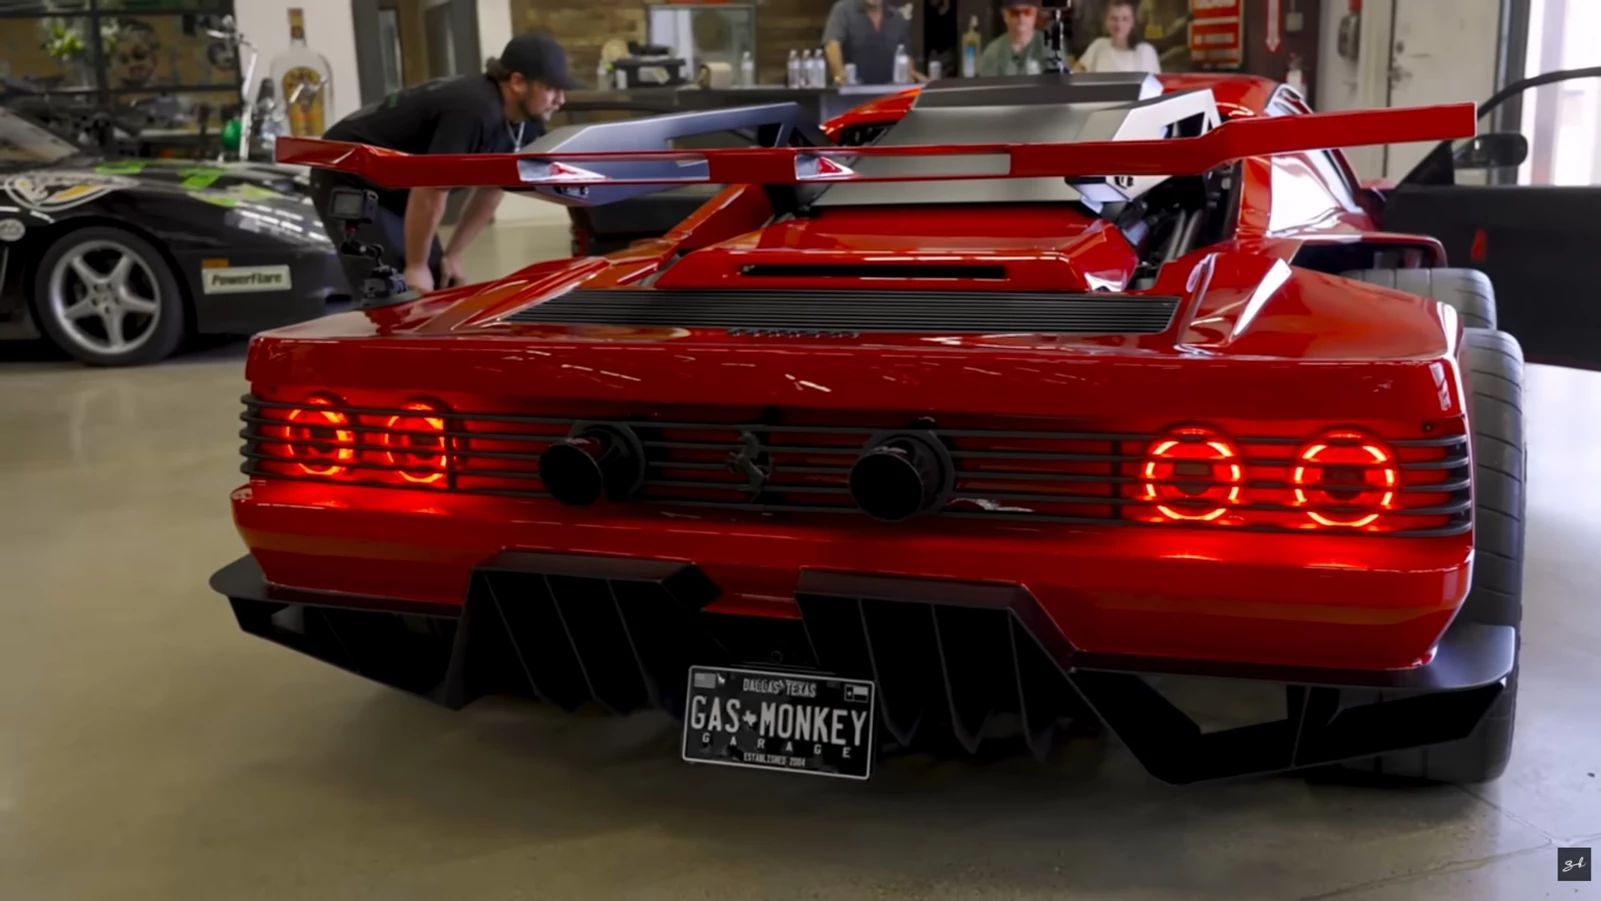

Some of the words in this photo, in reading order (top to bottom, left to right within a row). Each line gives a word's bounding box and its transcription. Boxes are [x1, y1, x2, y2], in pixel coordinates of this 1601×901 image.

[784, 679, 817, 699] TEXAS
[690, 695, 742, 733] GAS
[759, 701, 868, 747] MONKEY
[701, 732, 852, 759] GARAGE
